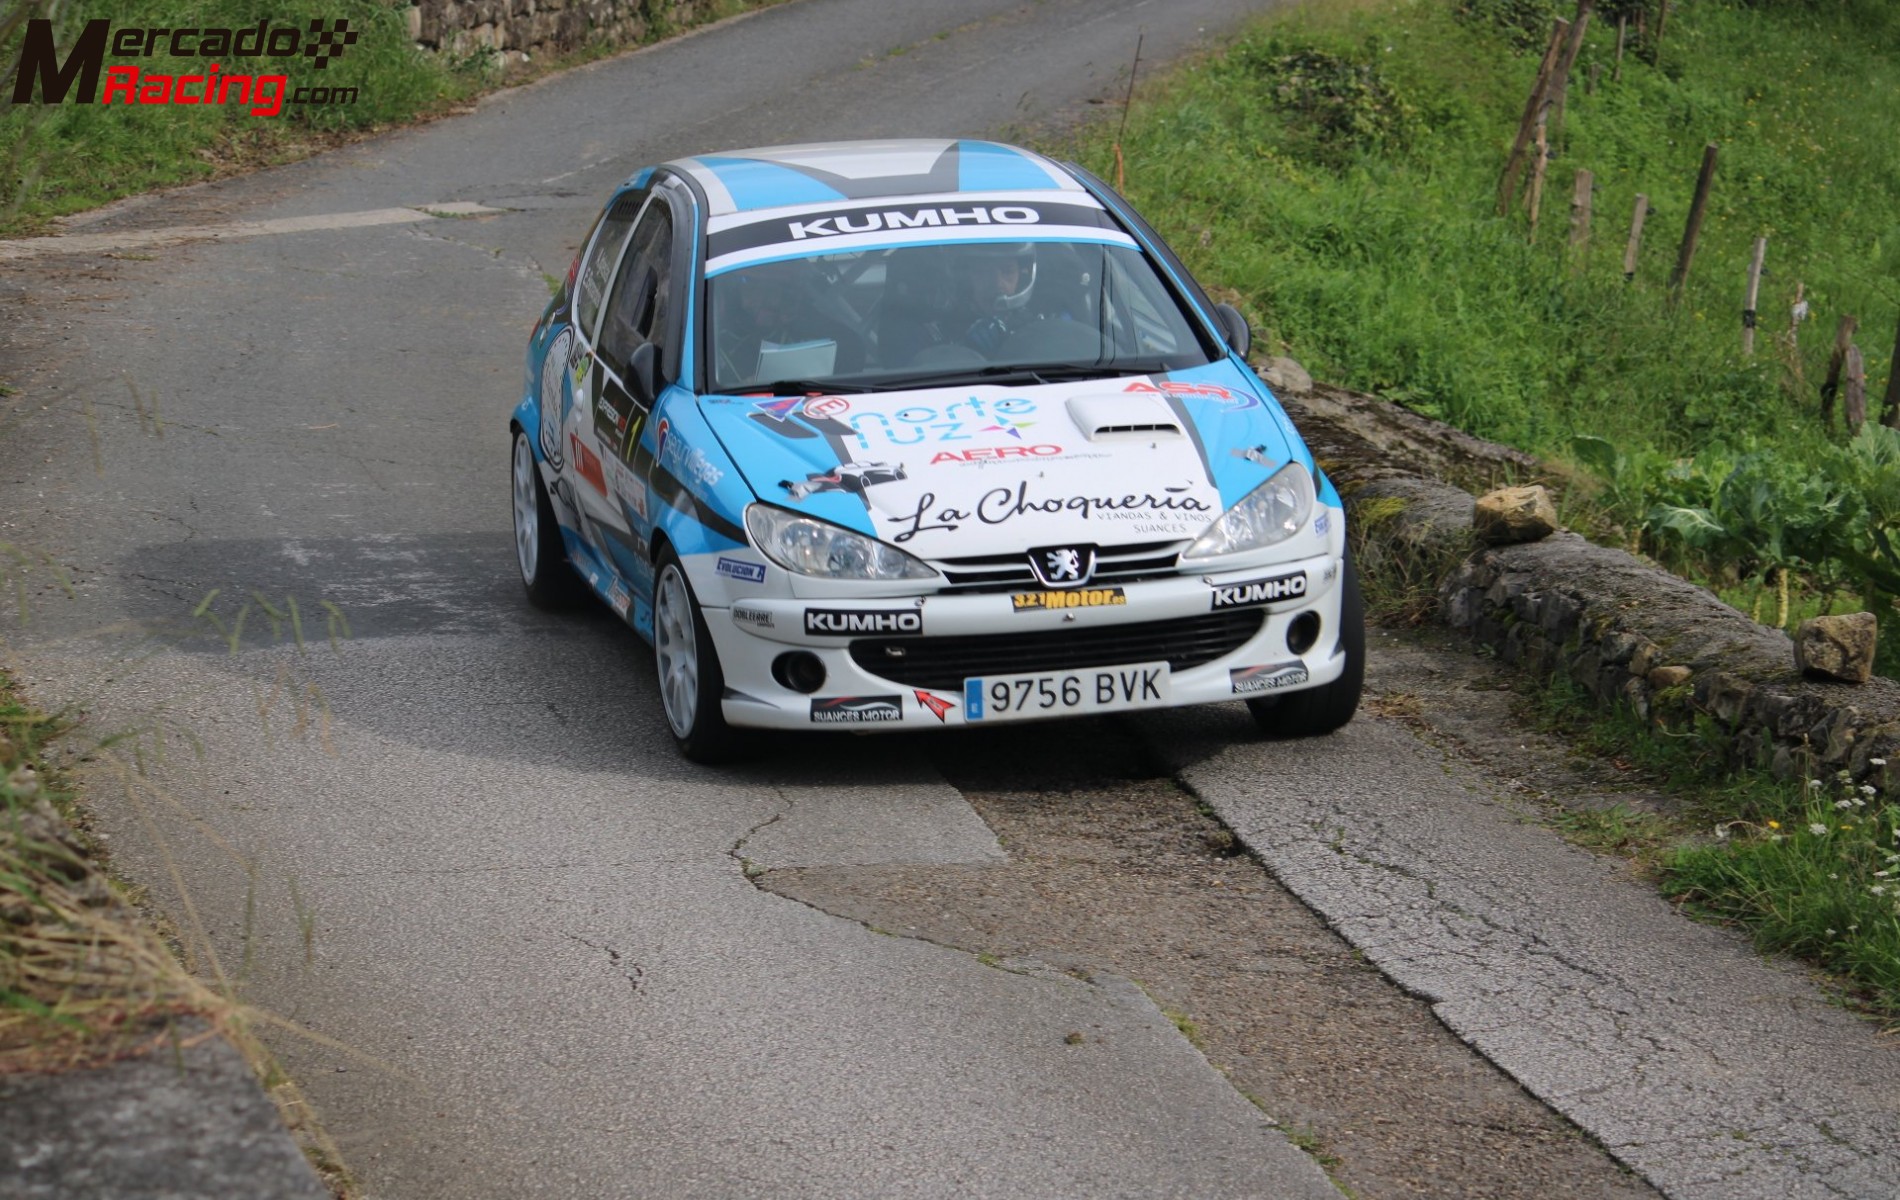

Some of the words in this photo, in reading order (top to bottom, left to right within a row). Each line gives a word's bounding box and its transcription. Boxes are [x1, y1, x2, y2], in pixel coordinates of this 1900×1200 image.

[788, 206, 1040, 240] KUMHO
[1123, 381, 1232, 400] ASR
[929, 444, 1063, 465] AERO
[887, 492, 970, 542] La
[1097, 512, 1152, 521] VIANDAS
[1159, 511, 1168, 521] &
[1173, 510, 1213, 522] VINOS
[1133, 523, 1187, 534] SUANCES
[1214, 576, 1306, 606] KUMHO
[807, 612, 921, 632] KUMHO
[990, 675, 1082, 713] 9756
[1096, 668, 1162, 705] BVK
[862, 709, 900, 721] MOTOR
